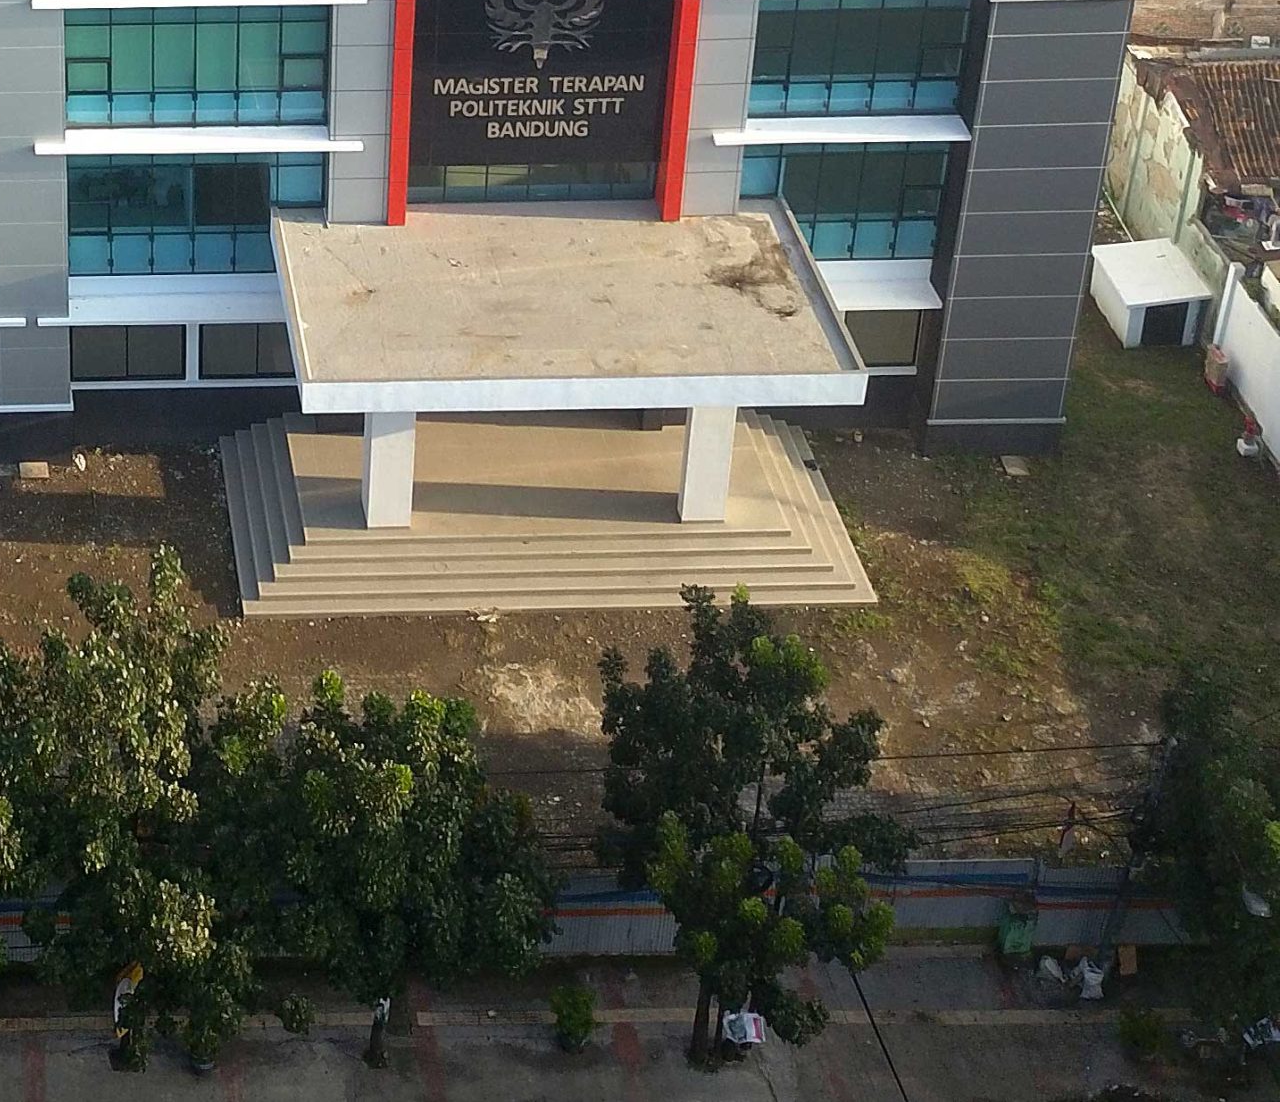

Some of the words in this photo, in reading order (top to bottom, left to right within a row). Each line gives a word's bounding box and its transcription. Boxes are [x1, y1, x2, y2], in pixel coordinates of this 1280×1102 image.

[434, 77, 538, 95] MAGISTER
[549, 75, 645, 93] TERAPAN
[450, 99, 564, 117] POLITEKNIK
[573, 98, 624, 114] STTT
[487, 121, 589, 139] BANDUNG
